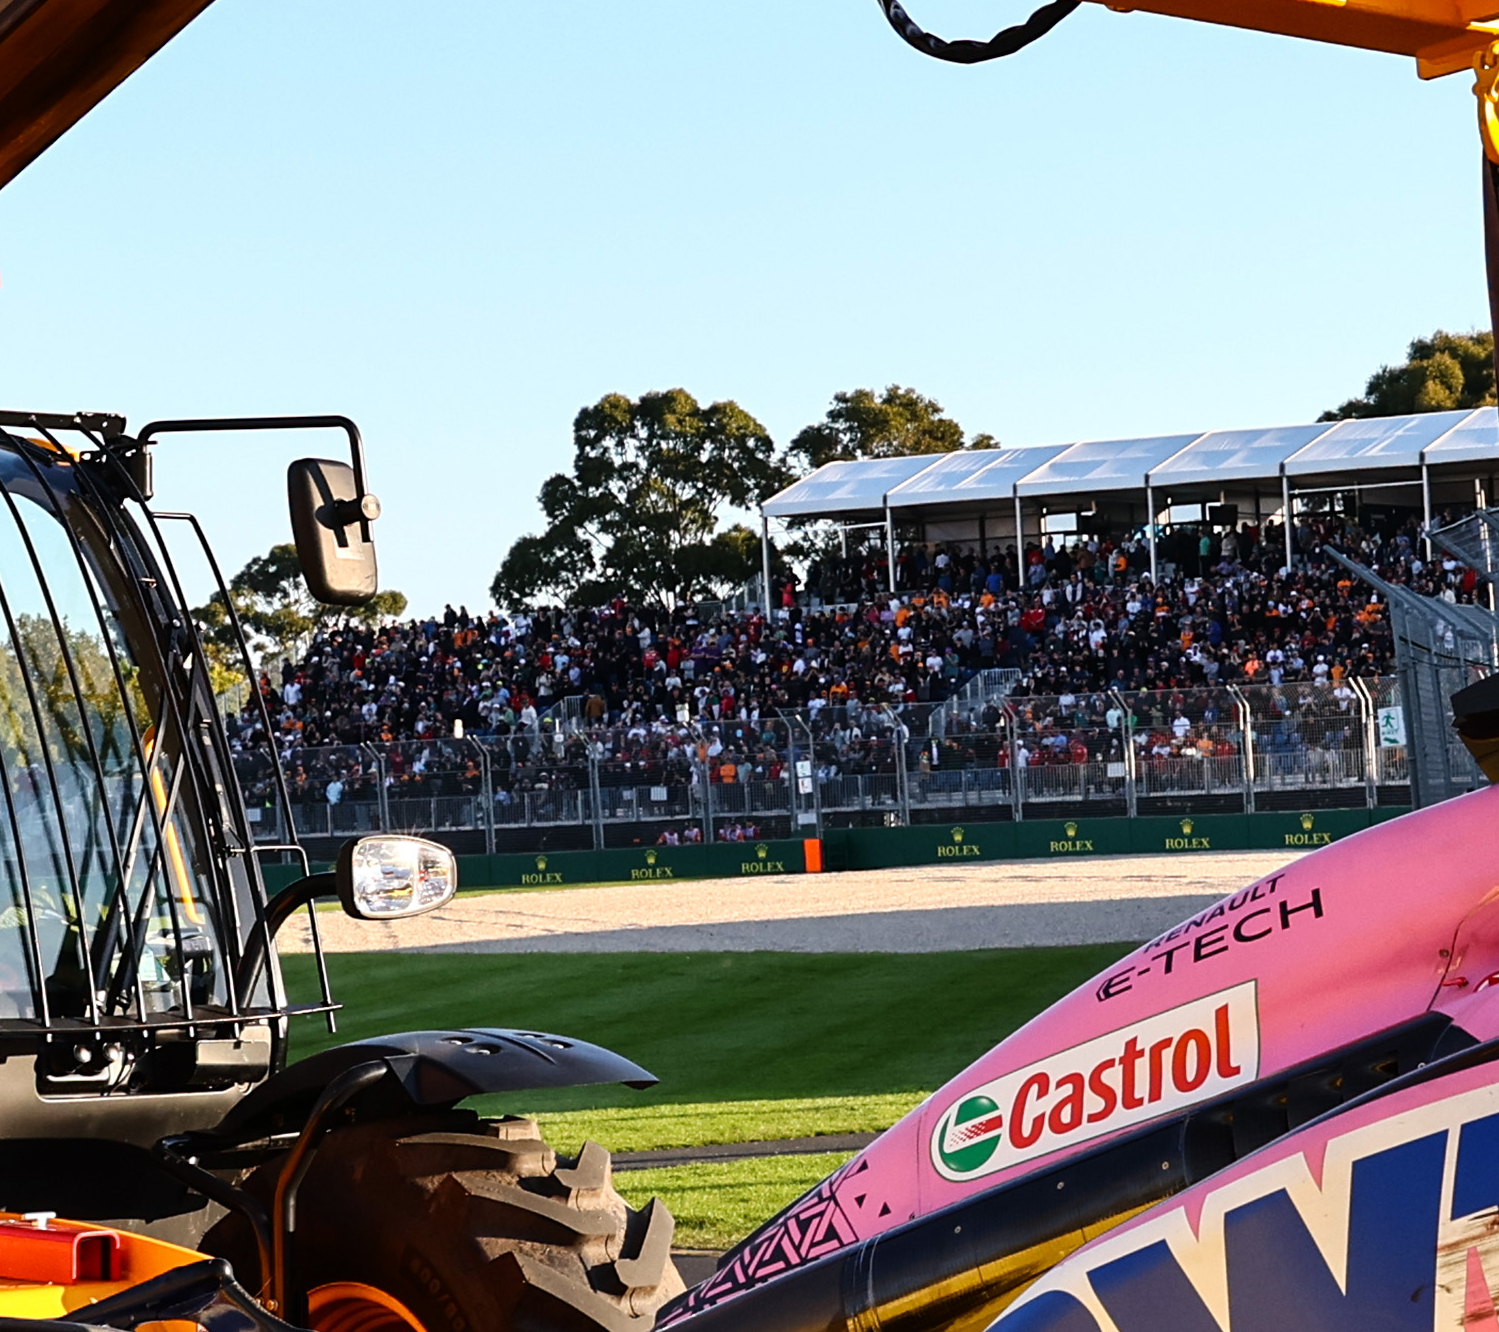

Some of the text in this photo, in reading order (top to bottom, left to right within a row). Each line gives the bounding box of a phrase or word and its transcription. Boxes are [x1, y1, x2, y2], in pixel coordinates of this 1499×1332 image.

[1165, 837, 1211, 850] ROLEX
[1285, 832, 1331, 846] ROLEX
[937, 844, 980, 857] ROLEX
[1050, 839, 1094, 853] ROLEX
[631, 867, 674, 880] ROLEX
[741, 861, 785, 874] ROLEX
[521, 873, 563, 885] ROLEX
[1143, 873, 1286, 954] RENAULT
[1096, 887, 1324, 1003] E-TECH
[1009, 1003, 1241, 1150] Castrol
